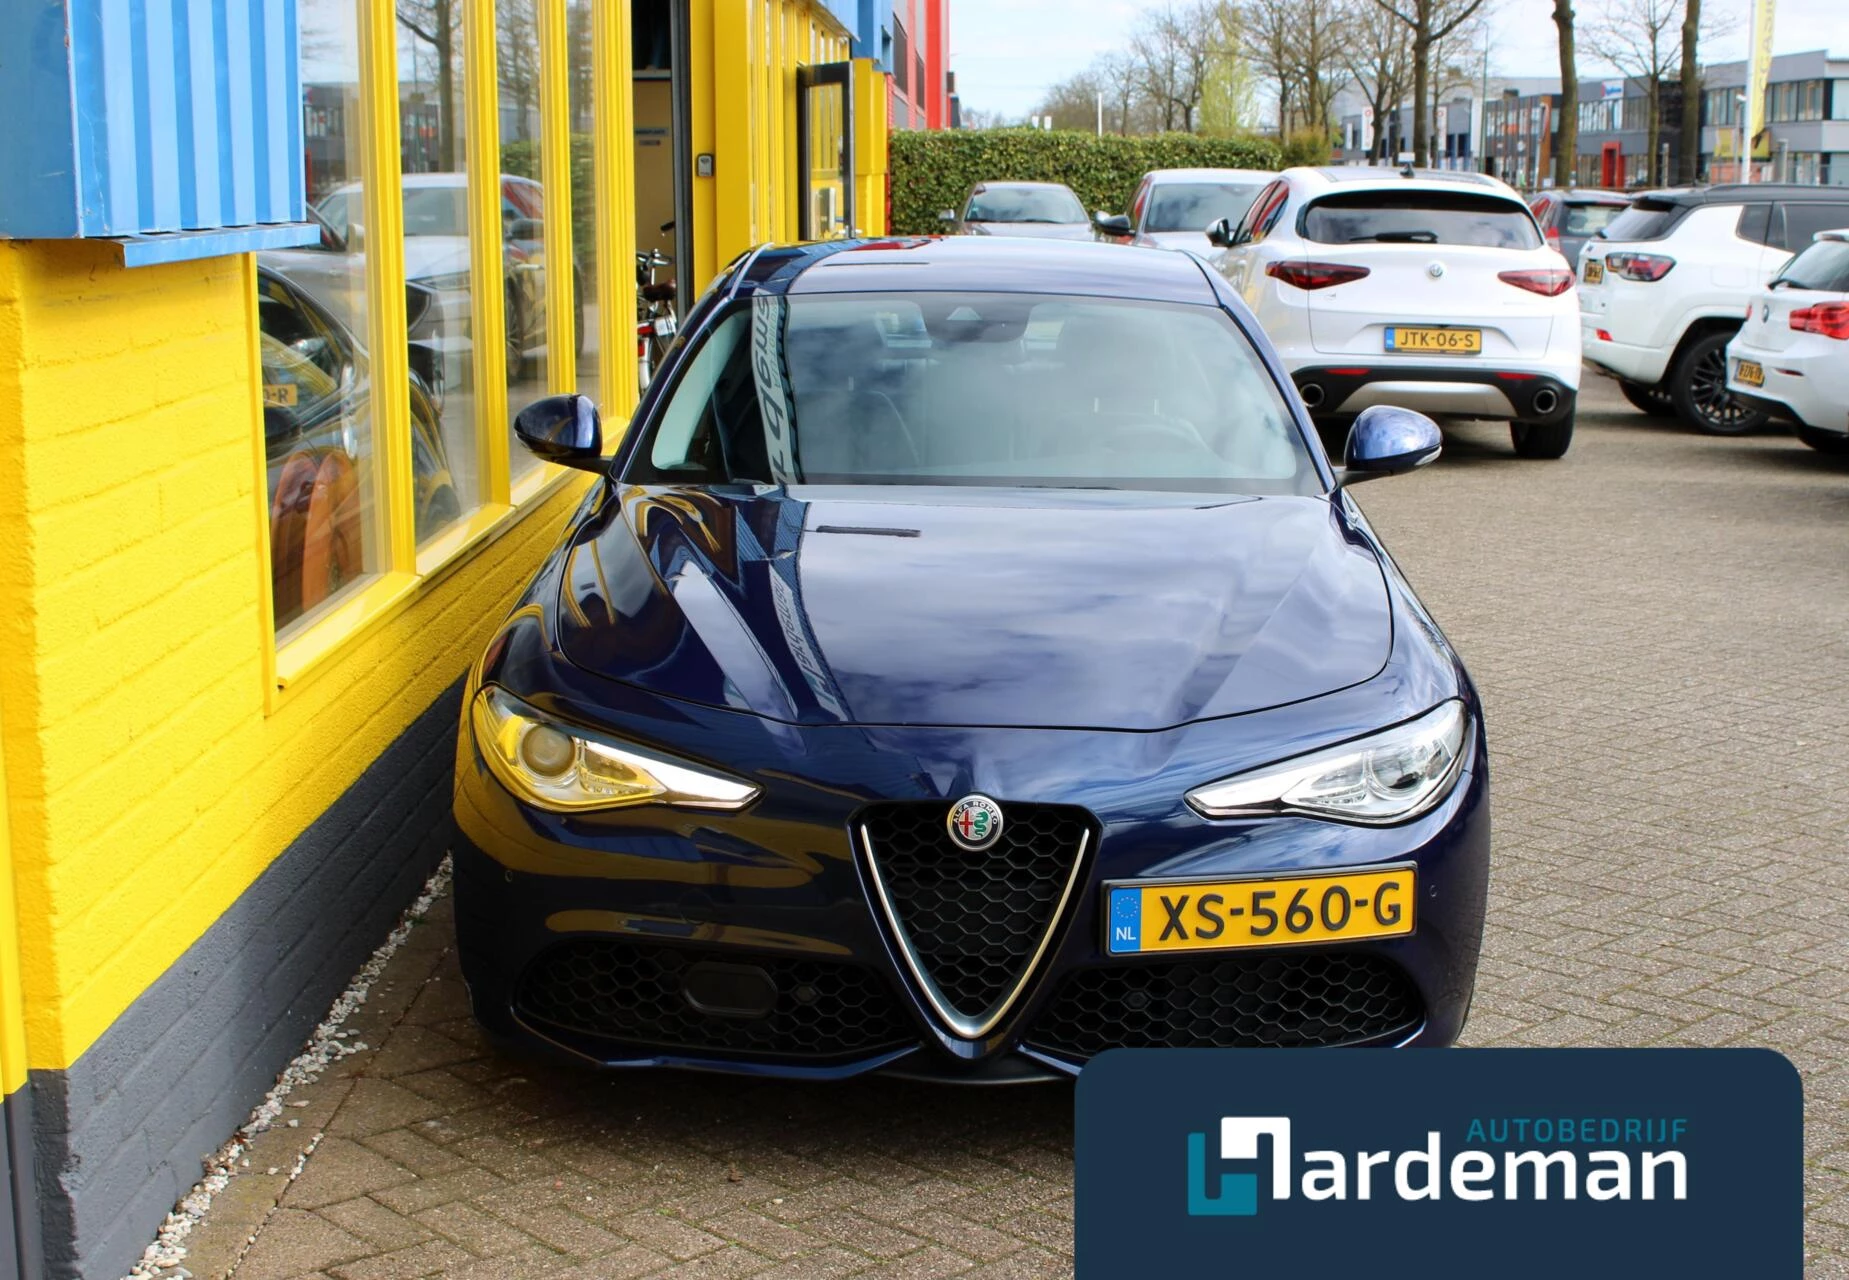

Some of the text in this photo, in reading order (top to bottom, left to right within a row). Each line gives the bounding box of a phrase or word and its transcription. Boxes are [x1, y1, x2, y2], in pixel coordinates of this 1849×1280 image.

[1401, 331, 1474, 348] JTK-06-S
[953, 801, 998, 825] ALFA ROMEO
[1115, 881, 1402, 942] NL XS-560-G
